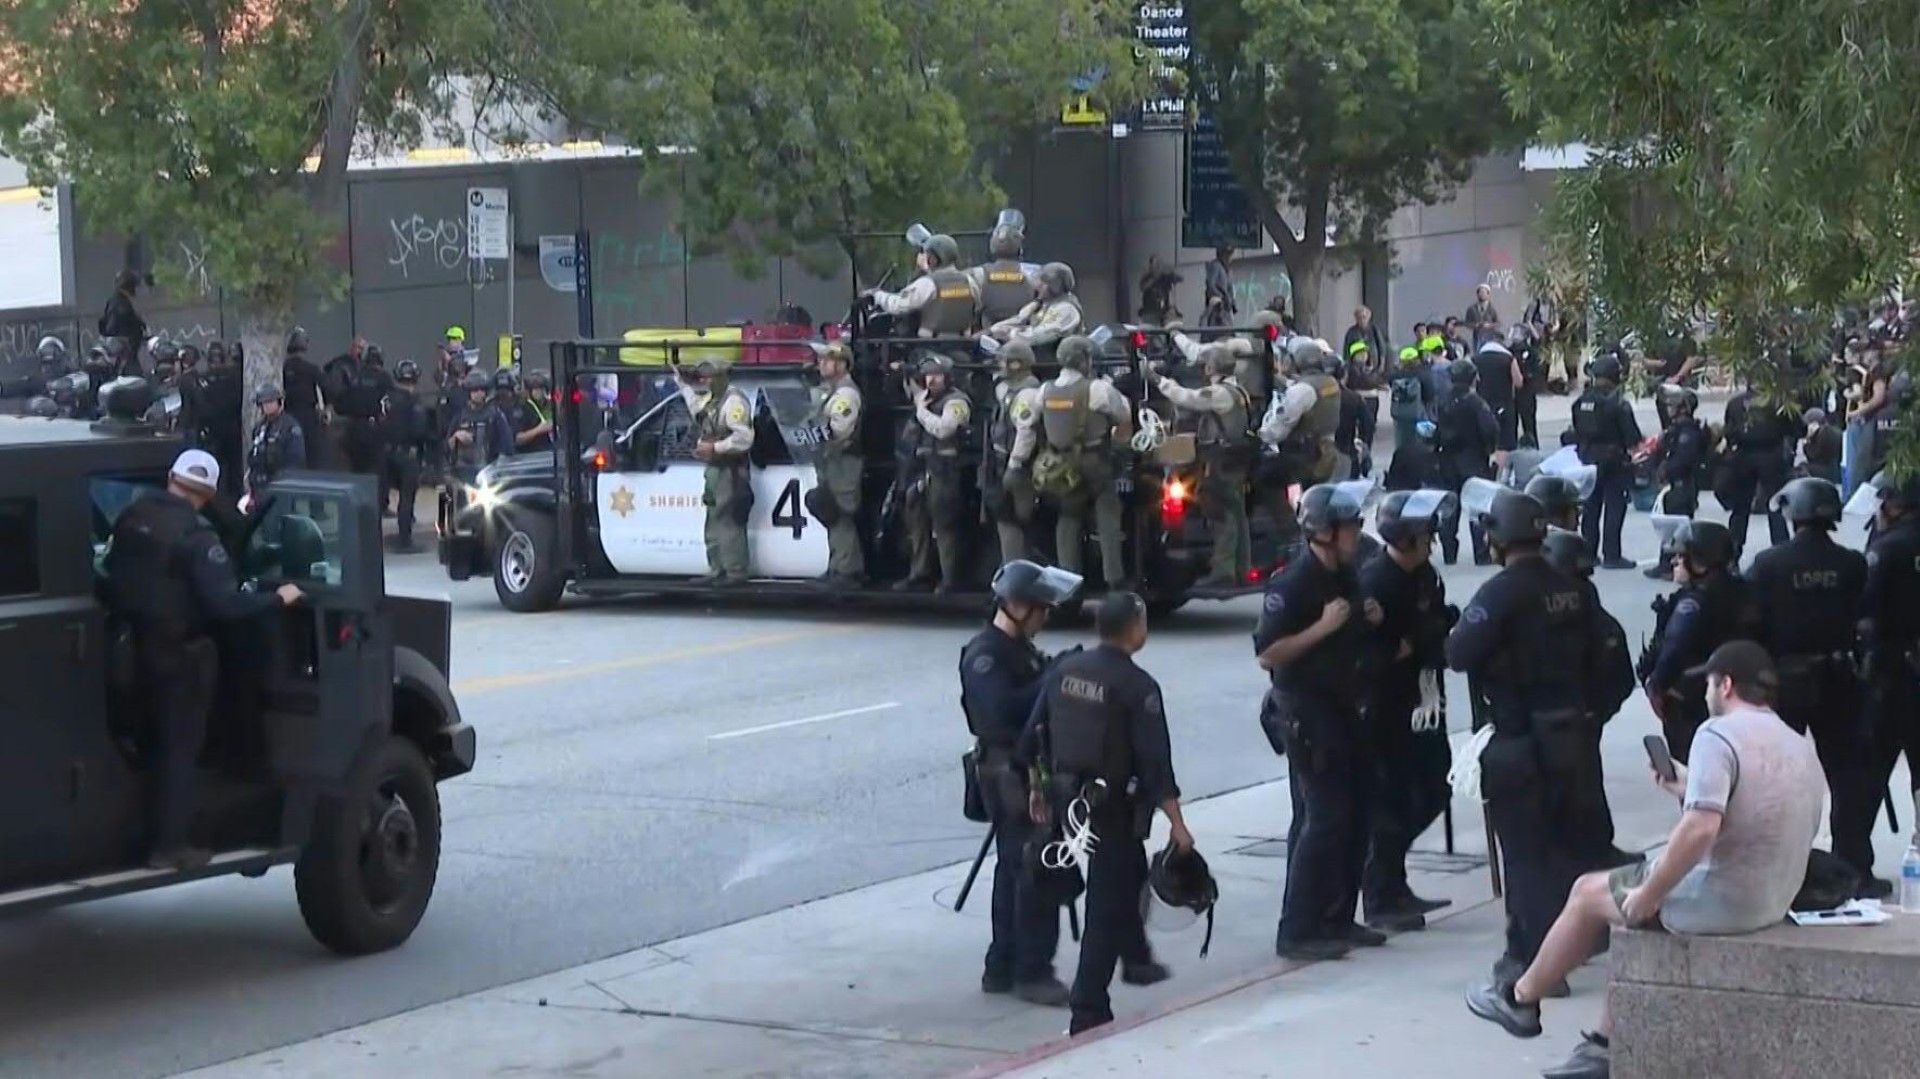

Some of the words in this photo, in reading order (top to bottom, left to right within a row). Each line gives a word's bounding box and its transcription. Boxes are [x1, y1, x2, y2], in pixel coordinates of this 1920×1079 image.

[1141, 6, 1183, 18] Dance
[1135, 25, 1188, 38] Theater
[1134, 44, 1190, 59] Cmedy
[1160, 99, 1184, 112] Phil
[771, 479, 807, 540] 4
